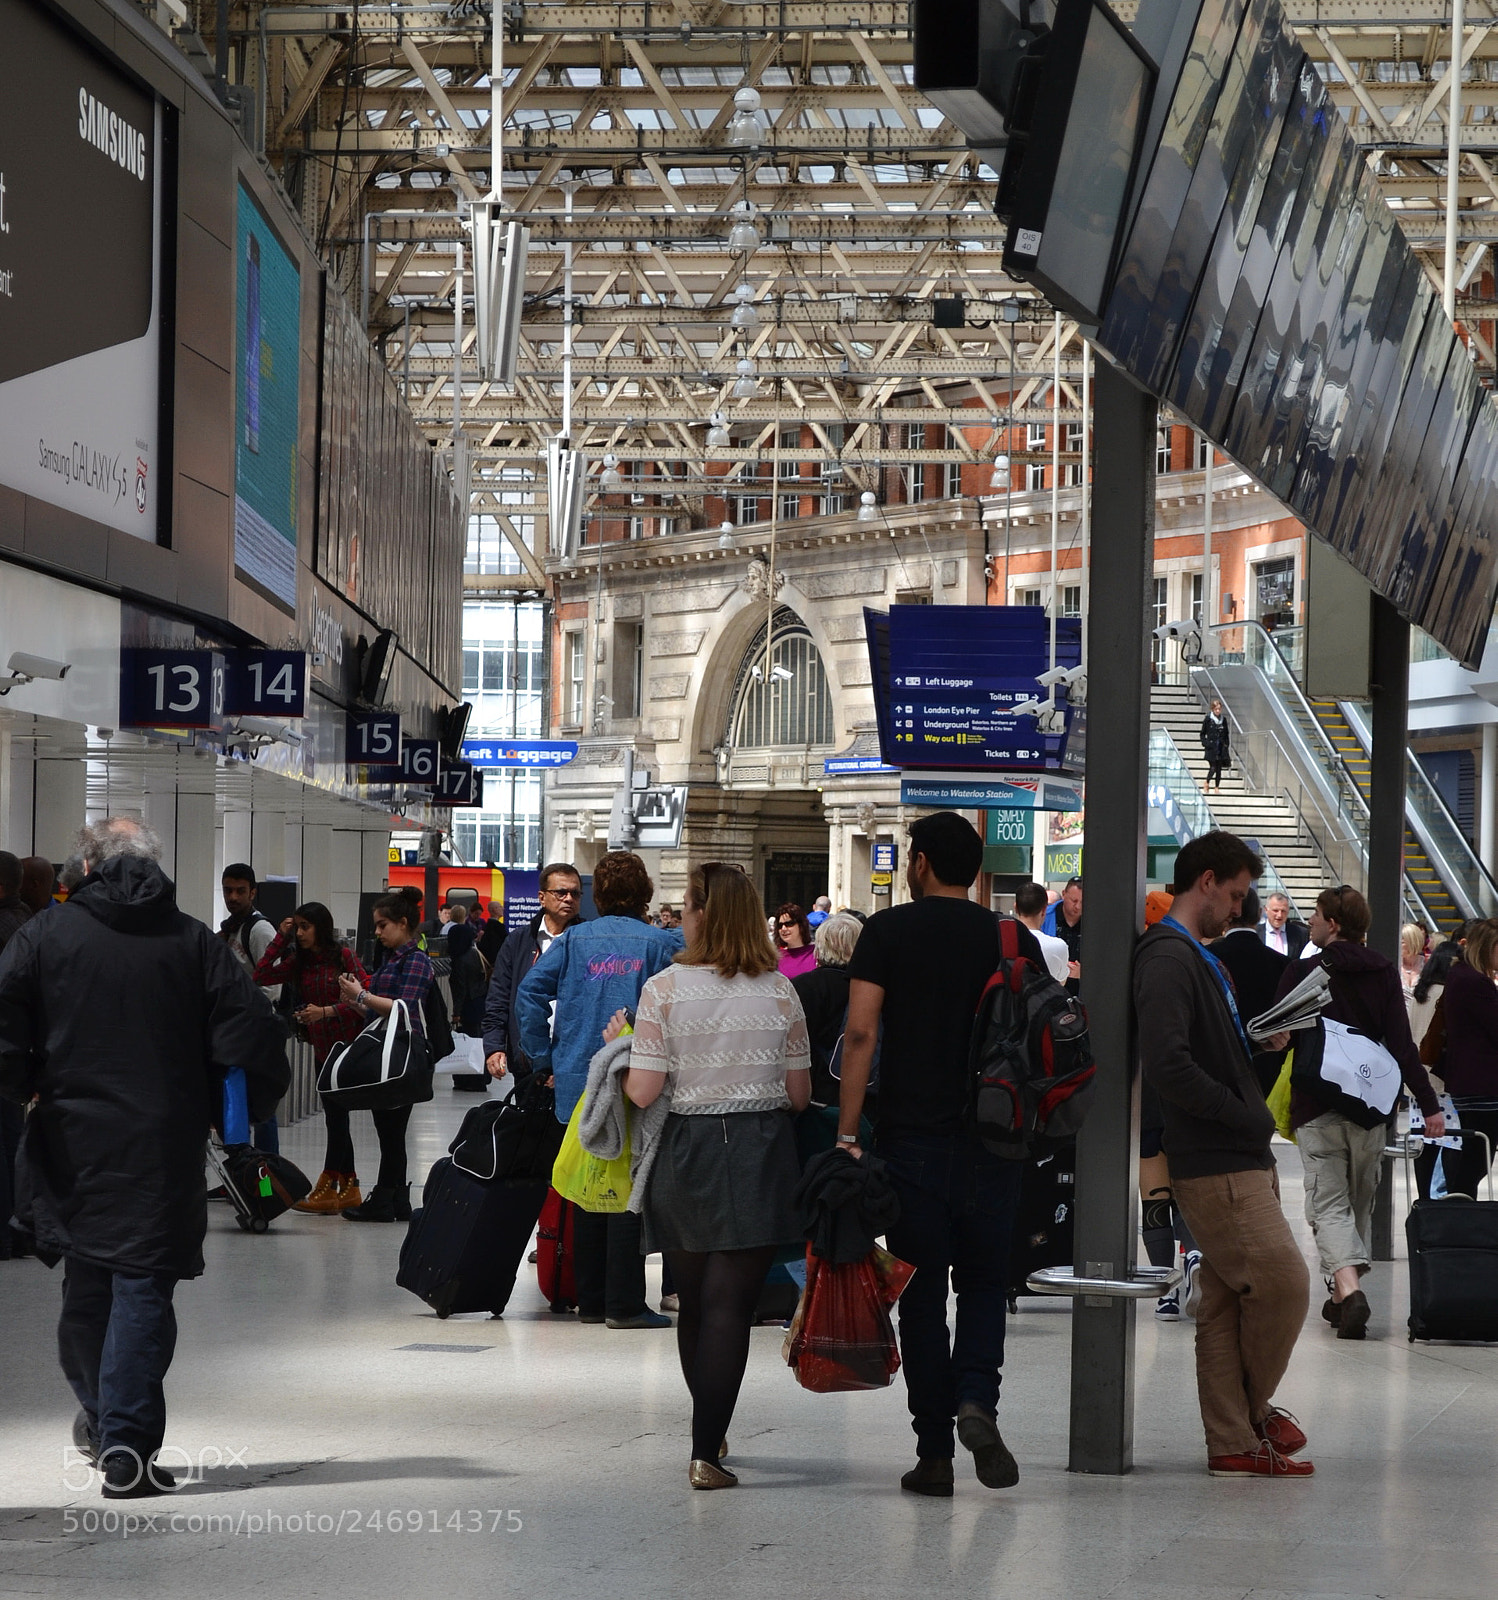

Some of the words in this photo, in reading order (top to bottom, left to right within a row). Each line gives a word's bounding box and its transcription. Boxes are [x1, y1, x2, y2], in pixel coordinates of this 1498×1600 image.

[78, 86, 146, 182] SAMSUNG
[1022, 232, 1037, 242] OIS
[1021, 243, 1032, 251] 40
[39, 438, 70, 485] Samsung
[72, 441, 111, 494] GALAXY
[147, 664, 201, 712] 13
[247, 662, 297, 704] 14
[925, 677, 940, 686] Left
[941, 678, 974, 688] Luggage
[212, 667, 224, 716] 13
[989, 692, 1013, 701] Toilets
[923, 706, 950, 714] London
[951, 706, 965, 716] Eye
[965, 706, 980, 715] Pier
[923, 720, 970, 730] Underground
[356, 722, 393, 754] 15
[924, 734, 940, 744] Way
[941, 735, 955, 743] out
[401, 747, 432, 776] 16
[460, 748, 492, 759] Left
[497, 748, 573, 763] Luggage
[984, 749, 1010, 758] Tickets
[439, 770, 468, 795] 17
[906, 787, 940, 797] Welcome
[940, 789, 949, 797] to
[950, 788, 985, 798] Waterloo
[985, 789, 1014, 799] Station
[997, 809, 1025, 823] SIMPLY
[997, 823, 1026, 840] FOOD
[1047, 853, 1073, 874] M&S
[590, 959, 645, 976] MANILOW
